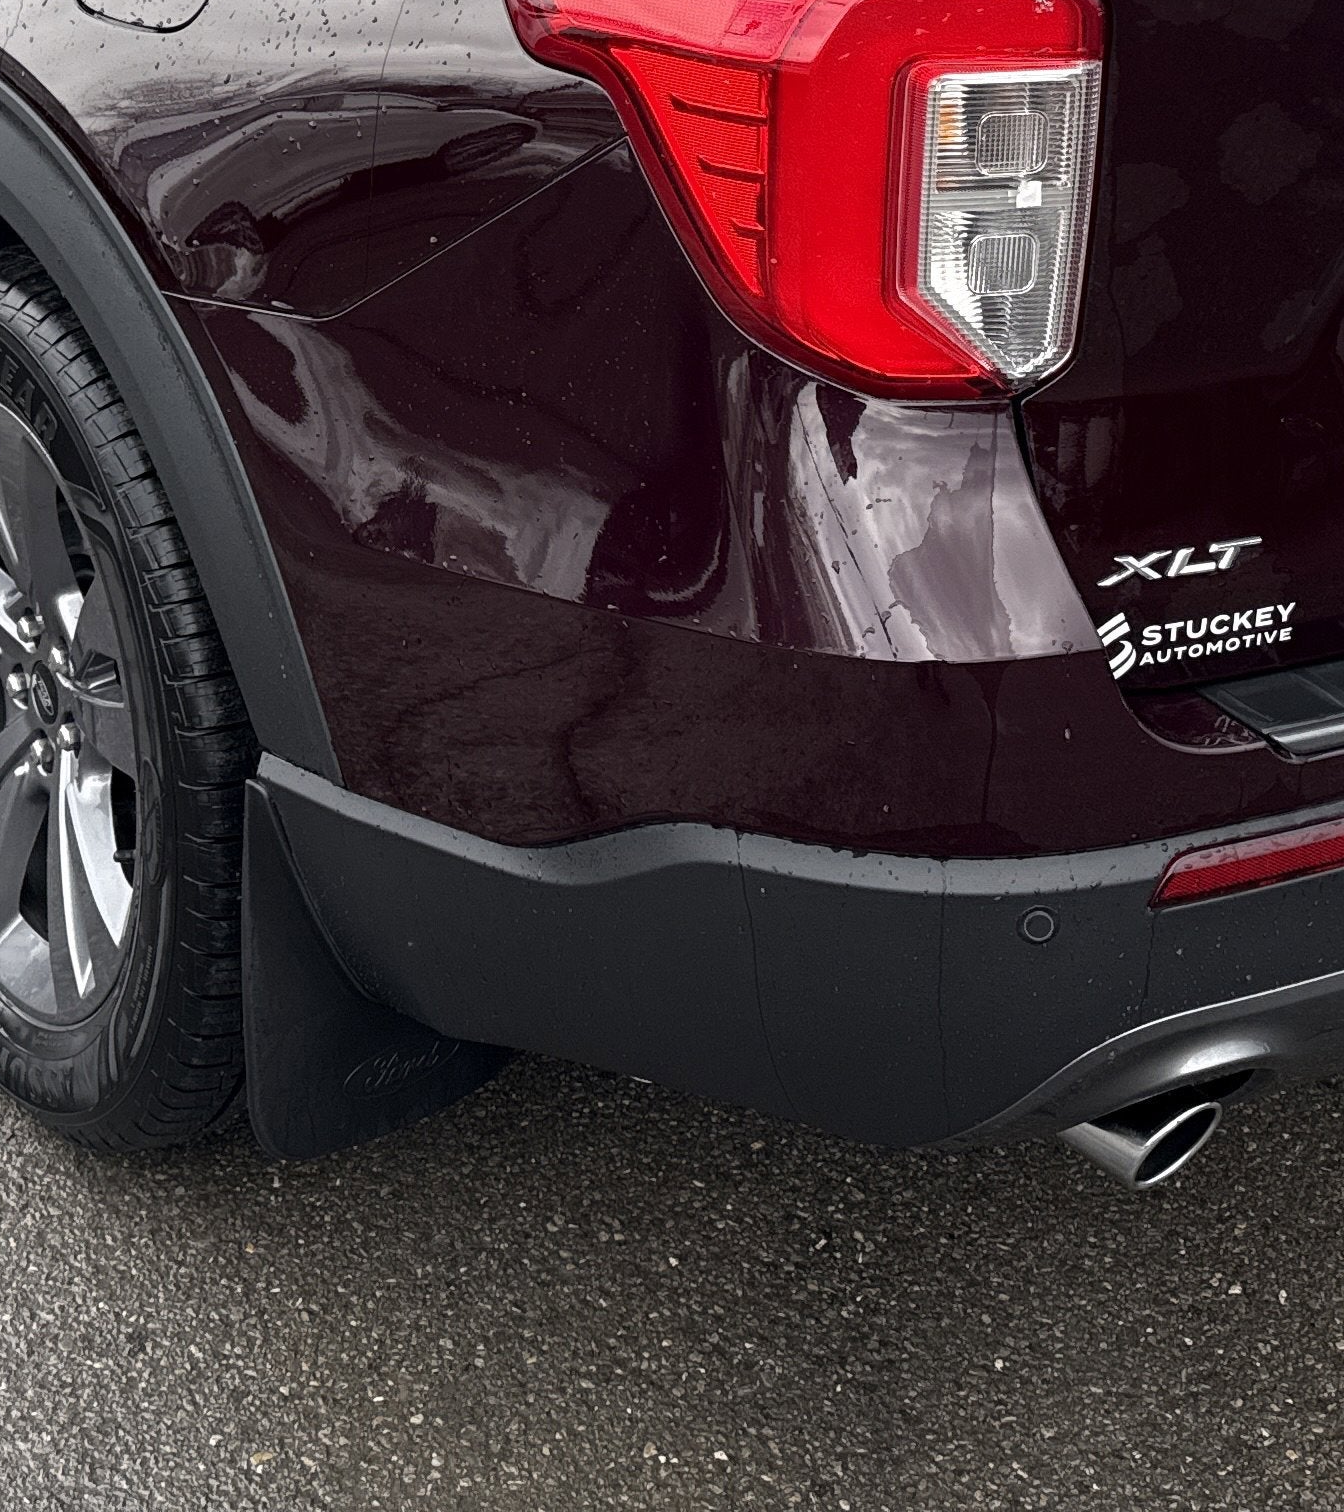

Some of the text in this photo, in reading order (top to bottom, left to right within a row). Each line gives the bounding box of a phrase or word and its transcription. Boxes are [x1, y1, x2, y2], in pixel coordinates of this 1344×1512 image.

[1096, 535, 1263, 587] XLT
[1139, 626, 1294, 666] AUTOMOTIVE
[1140, 601, 1296, 646] STUCKEY
